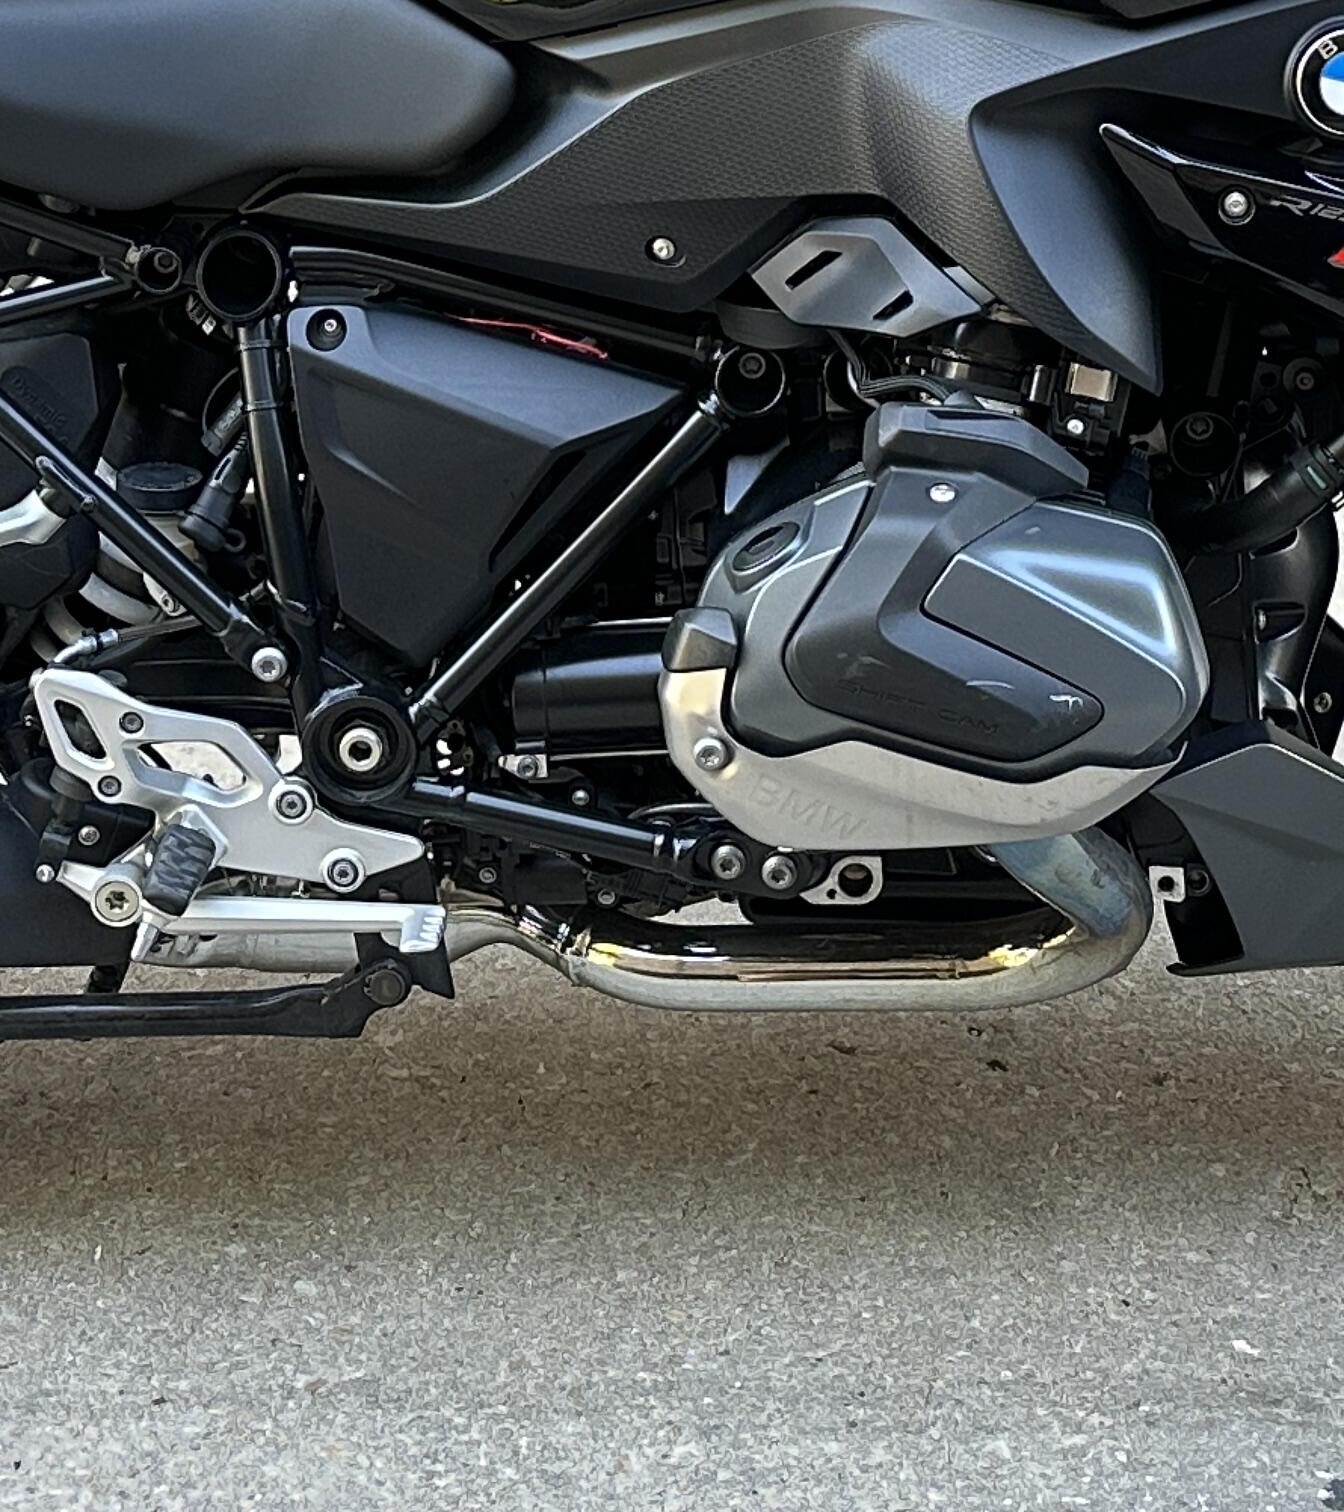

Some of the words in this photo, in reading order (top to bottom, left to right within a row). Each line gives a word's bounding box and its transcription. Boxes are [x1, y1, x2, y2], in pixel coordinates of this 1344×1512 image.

[837, 678, 928, 712] SHIFT
[936, 707, 1001, 735] CAM
[748, 772, 869, 840] BMW
